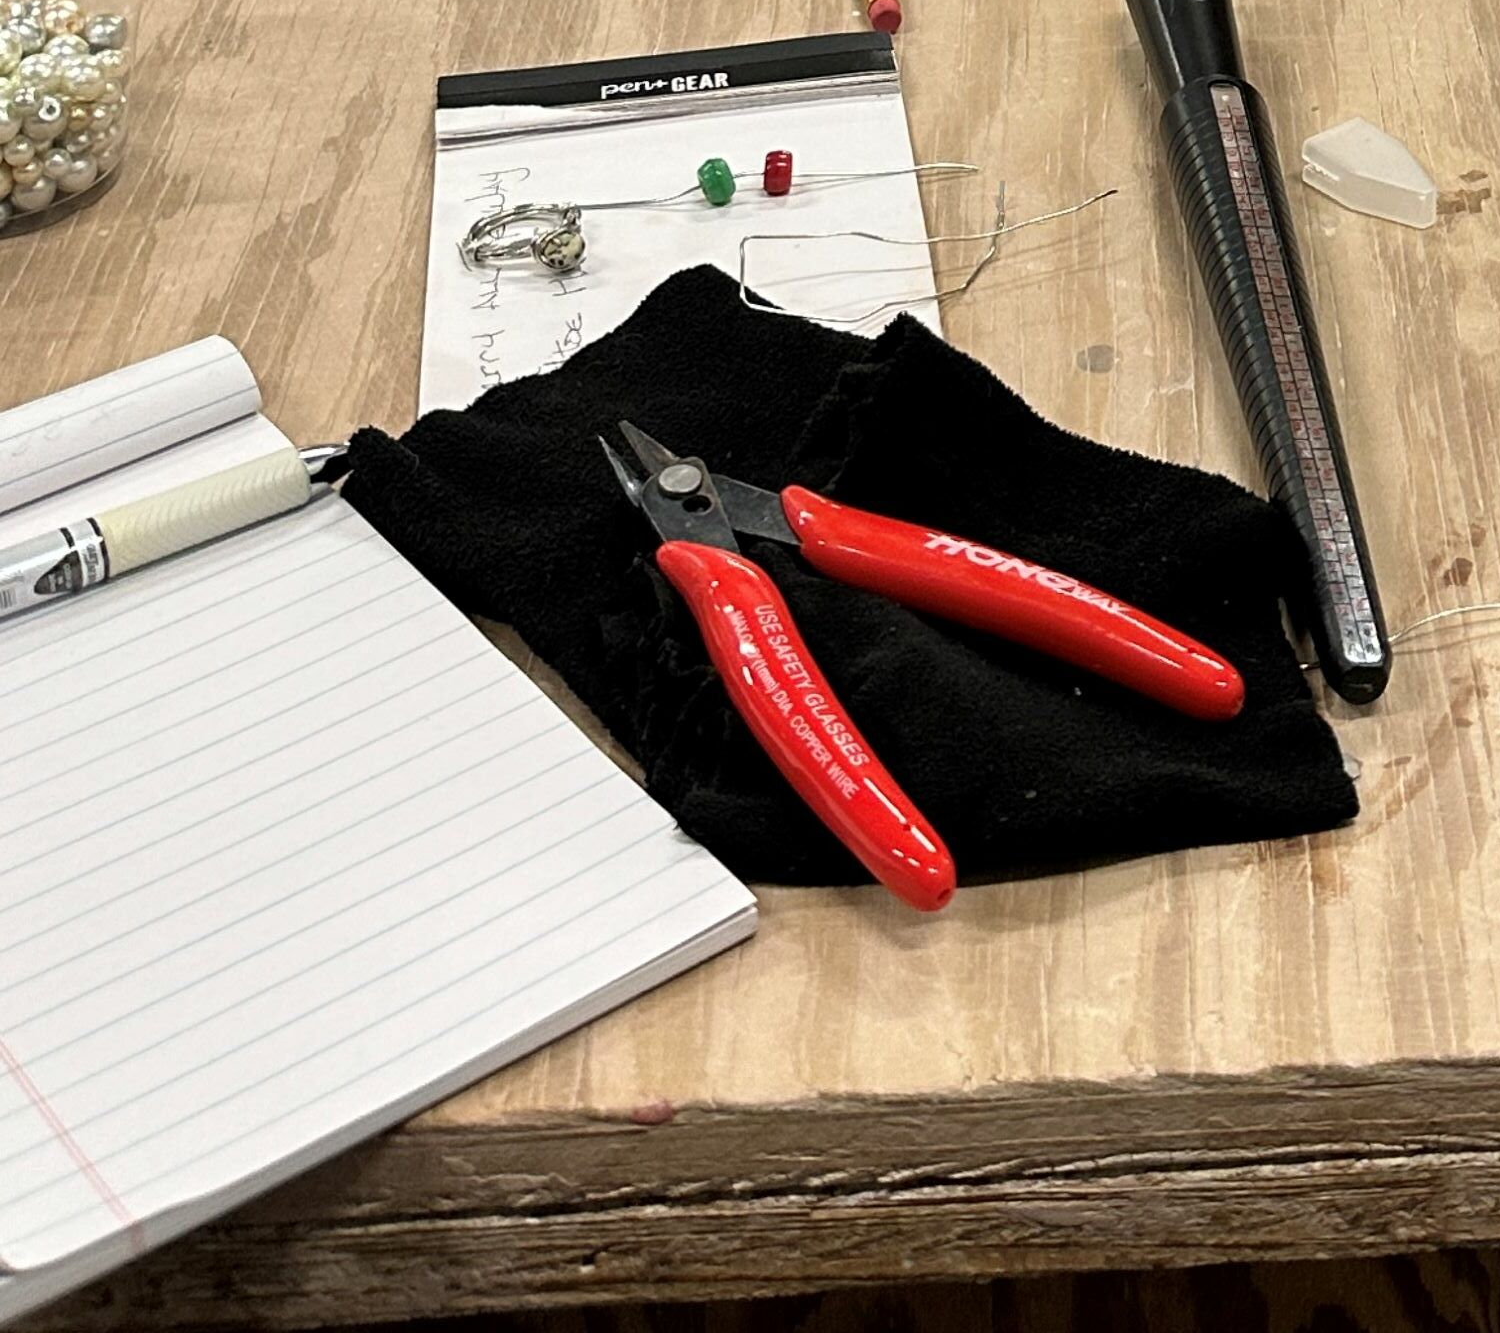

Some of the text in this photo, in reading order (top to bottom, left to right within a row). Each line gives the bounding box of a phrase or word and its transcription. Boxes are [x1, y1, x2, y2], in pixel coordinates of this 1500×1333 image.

[755, 604, 870, 767] USE SAFETY GLASSES
[789, 715, 833, 768] COPPER
[826, 759, 861, 800] WIRE
